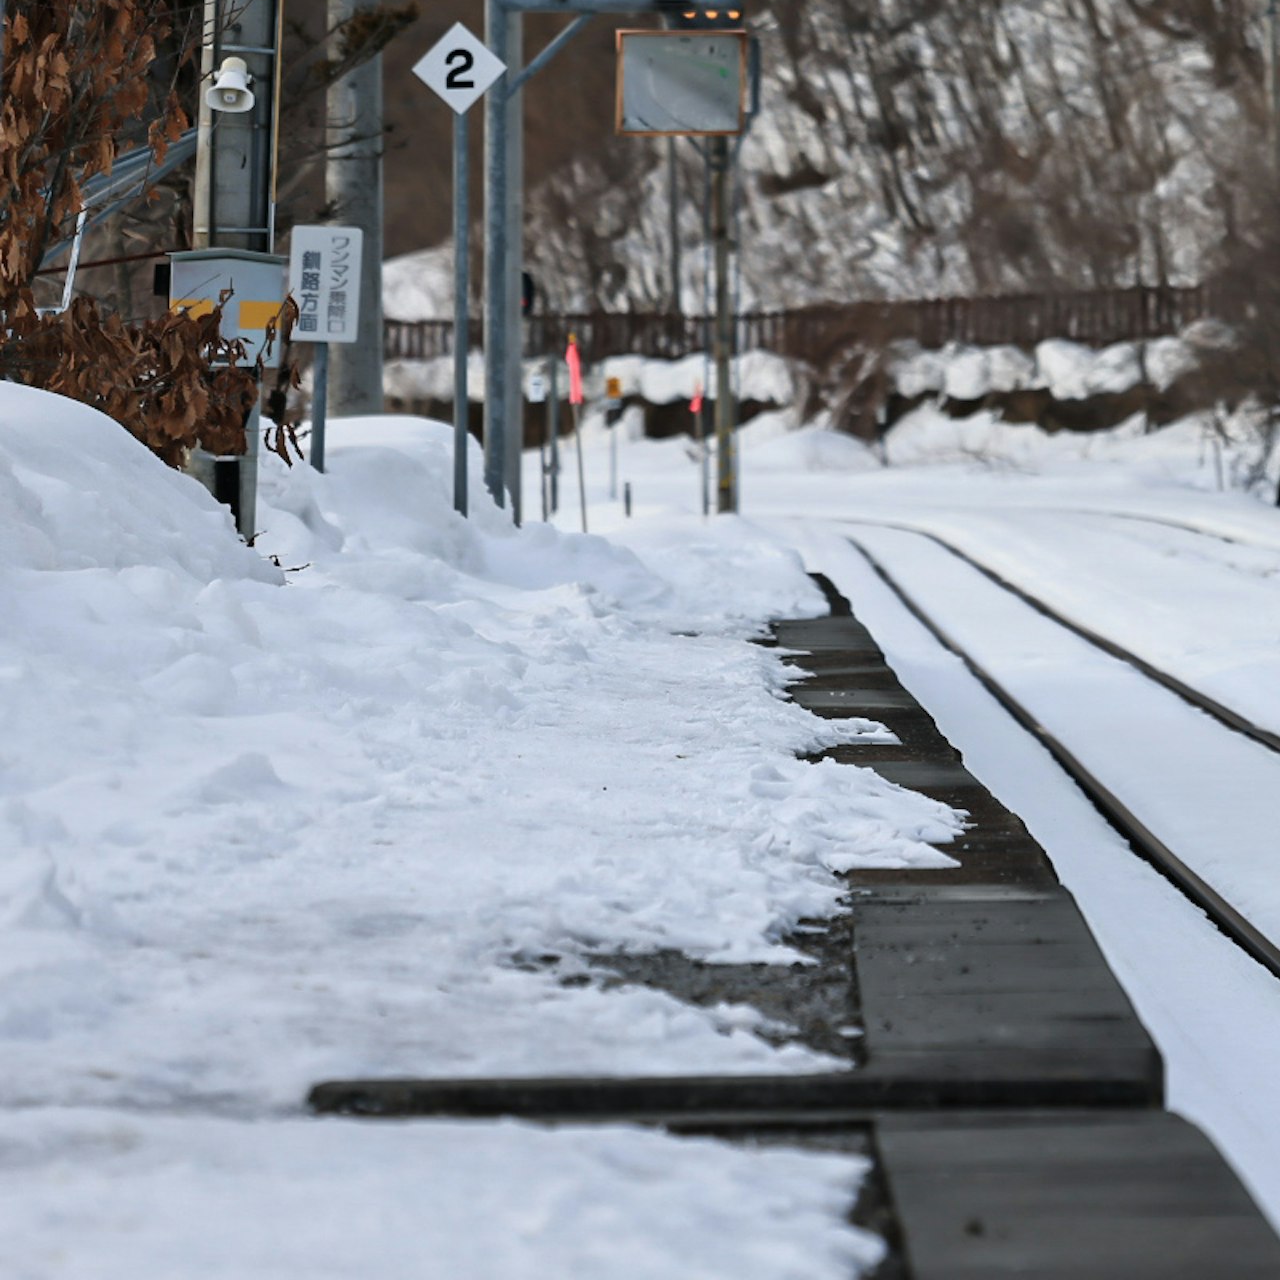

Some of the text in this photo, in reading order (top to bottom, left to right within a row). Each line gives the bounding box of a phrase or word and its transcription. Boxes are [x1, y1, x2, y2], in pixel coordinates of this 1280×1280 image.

[445, 48, 474, 89] 2
[299, 250, 321, 332] 釧路方面
